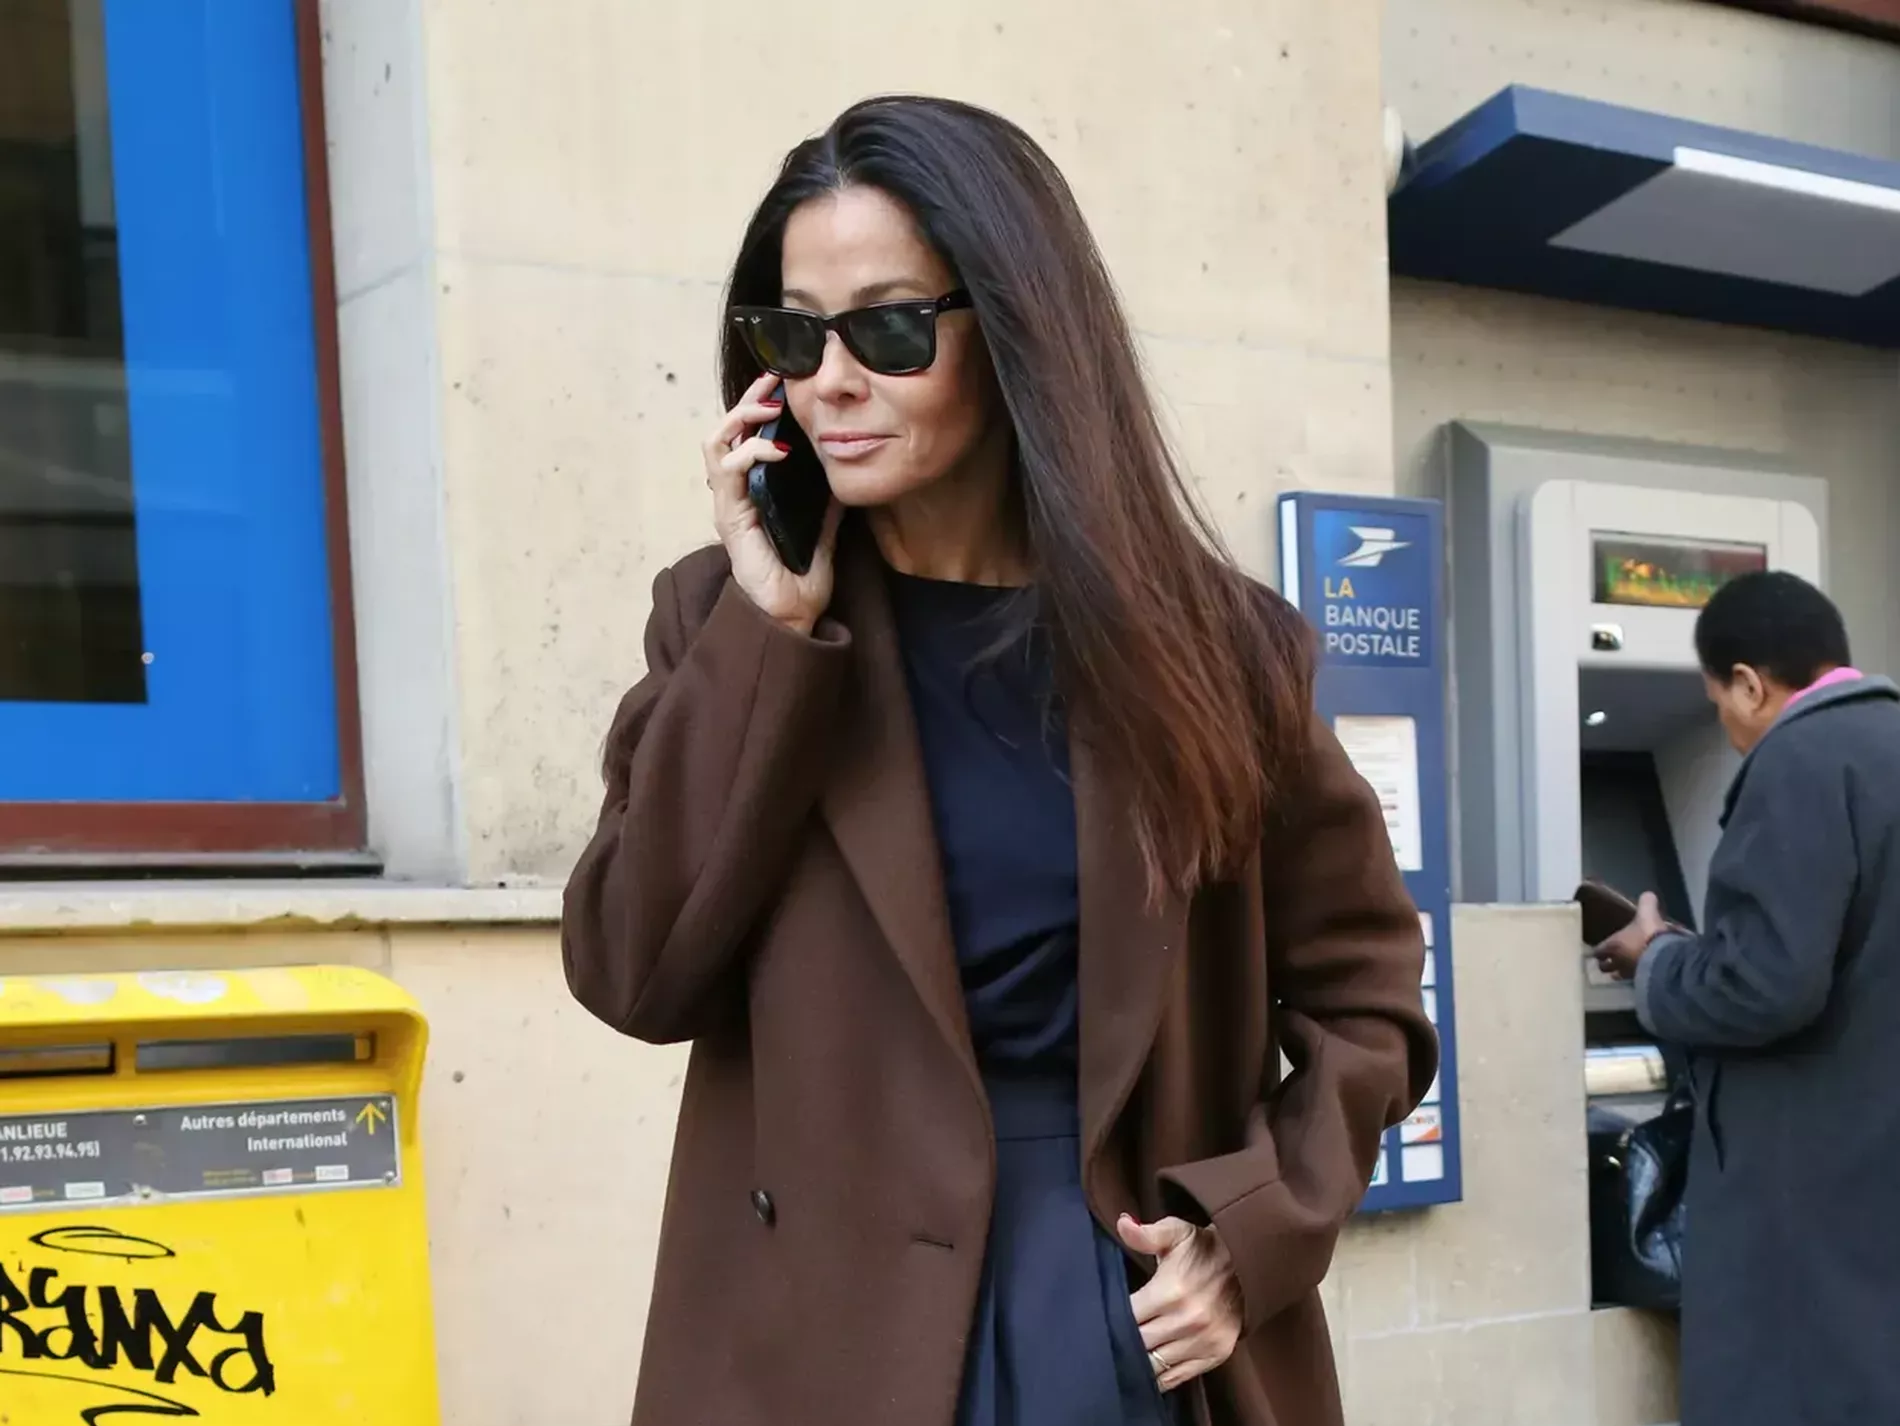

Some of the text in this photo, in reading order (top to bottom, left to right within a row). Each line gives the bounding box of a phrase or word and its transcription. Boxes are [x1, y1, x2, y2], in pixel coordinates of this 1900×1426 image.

[1324, 576, 1354, 599] LA
[1325, 604, 1420, 631] BANQUE
[1326, 632, 1420, 657] POSTALE
[180, 1109, 346, 1131] Autres départements
[247, 1132, 348, 1153] International
